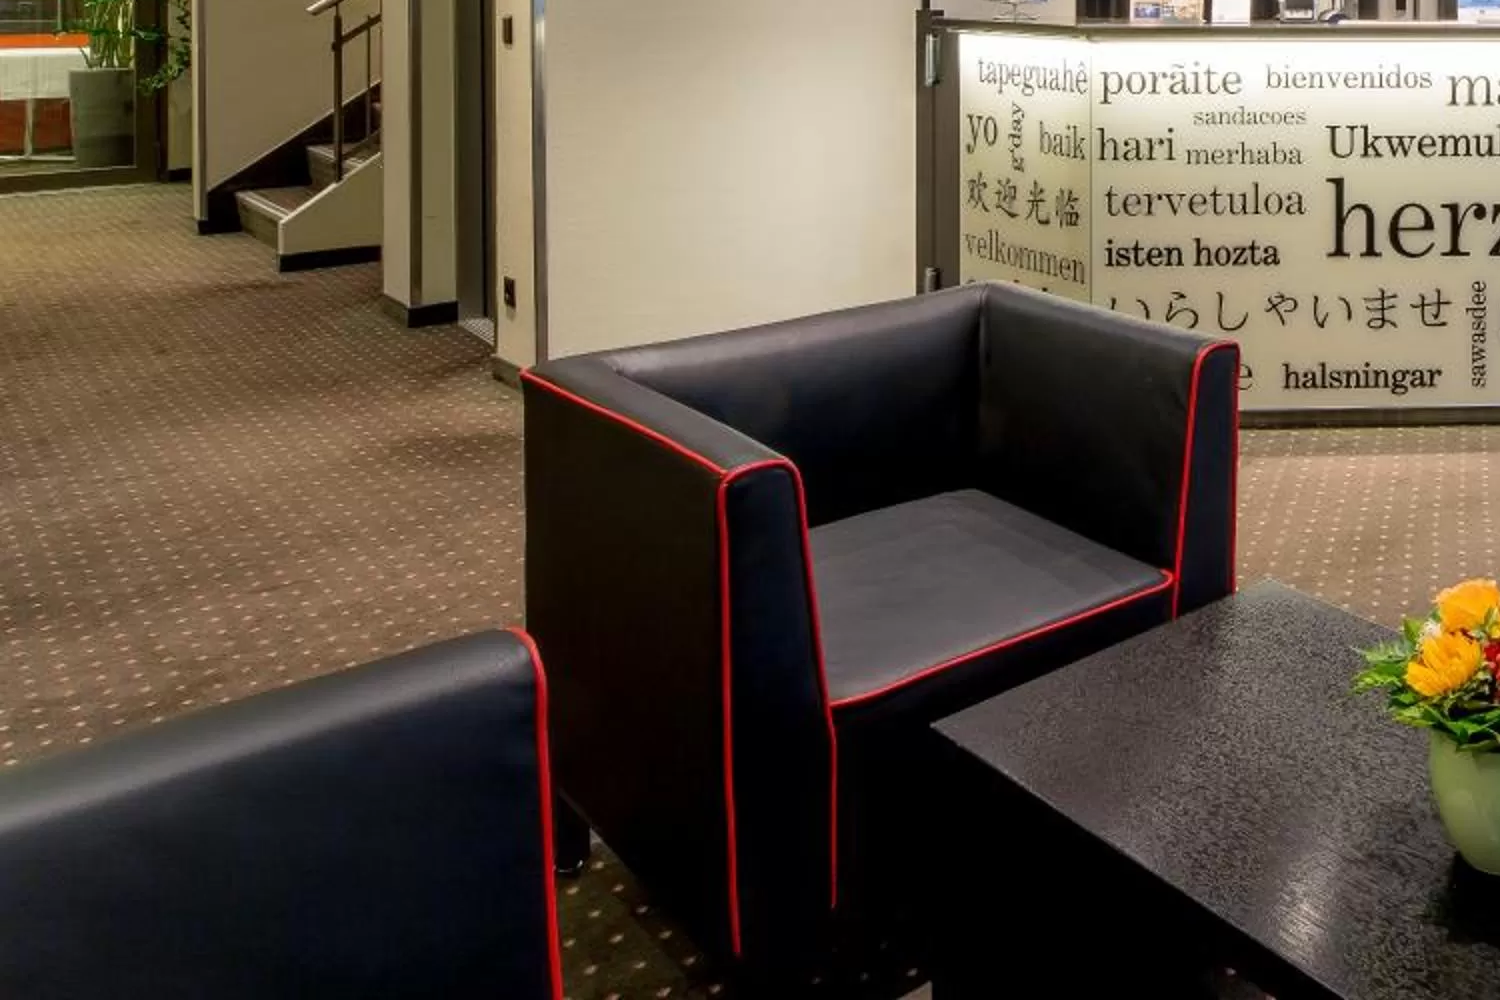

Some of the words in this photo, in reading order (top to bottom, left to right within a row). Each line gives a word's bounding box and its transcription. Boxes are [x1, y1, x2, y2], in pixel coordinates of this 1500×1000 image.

[1265, 63, 1433, 89] bienvenidos
[966, 113, 998, 154] yo
[1039, 119, 1086, 161] baik
[1097, 127, 1176, 162] hari
[1186, 141, 1303, 165] merhaba
[966, 171, 1081, 228] 欢迎光临
[1105, 182, 1307, 217] tervetuloa
[963, 228, 1086, 285] velkommen
[1104, 238, 1184, 268] isten
[1193, 237, 1280, 268] hozta
[1465, 281, 1487, 388] sawasdee
[1282, 361, 1442, 395] halsningar
